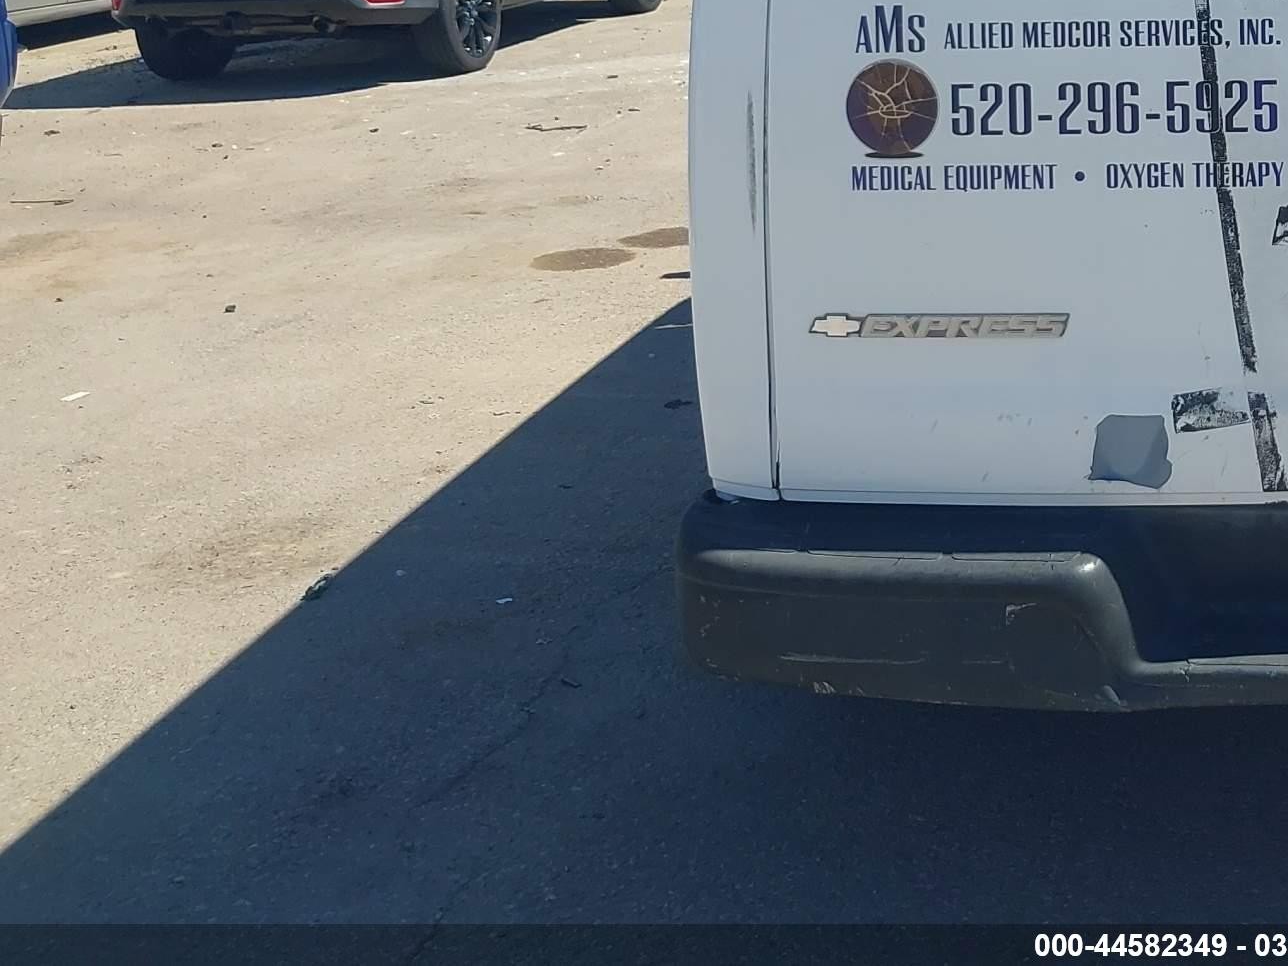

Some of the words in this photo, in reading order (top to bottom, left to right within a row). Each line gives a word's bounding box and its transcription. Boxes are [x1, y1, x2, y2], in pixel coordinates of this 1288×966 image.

[856, 4, 926, 54] AMS
[944, 22, 1014, 50] ALLIED
[1022, 20, 1111, 49] MEDCOR
[1119, 19, 1231, 48] SERVICES,
[1239, 18, 1281, 46] INC.
[950, 79, 1278, 136] 520-296-5925
[851, 165, 937, 191] MEDICAL
[943, 164, 1058, 193] EQUIPMENT
[1106, 161, 1185, 189] OXYGEN
[1191, 161, 1284, 188] THERAPY
[862, 313, 1069, 338] EXPRESS
